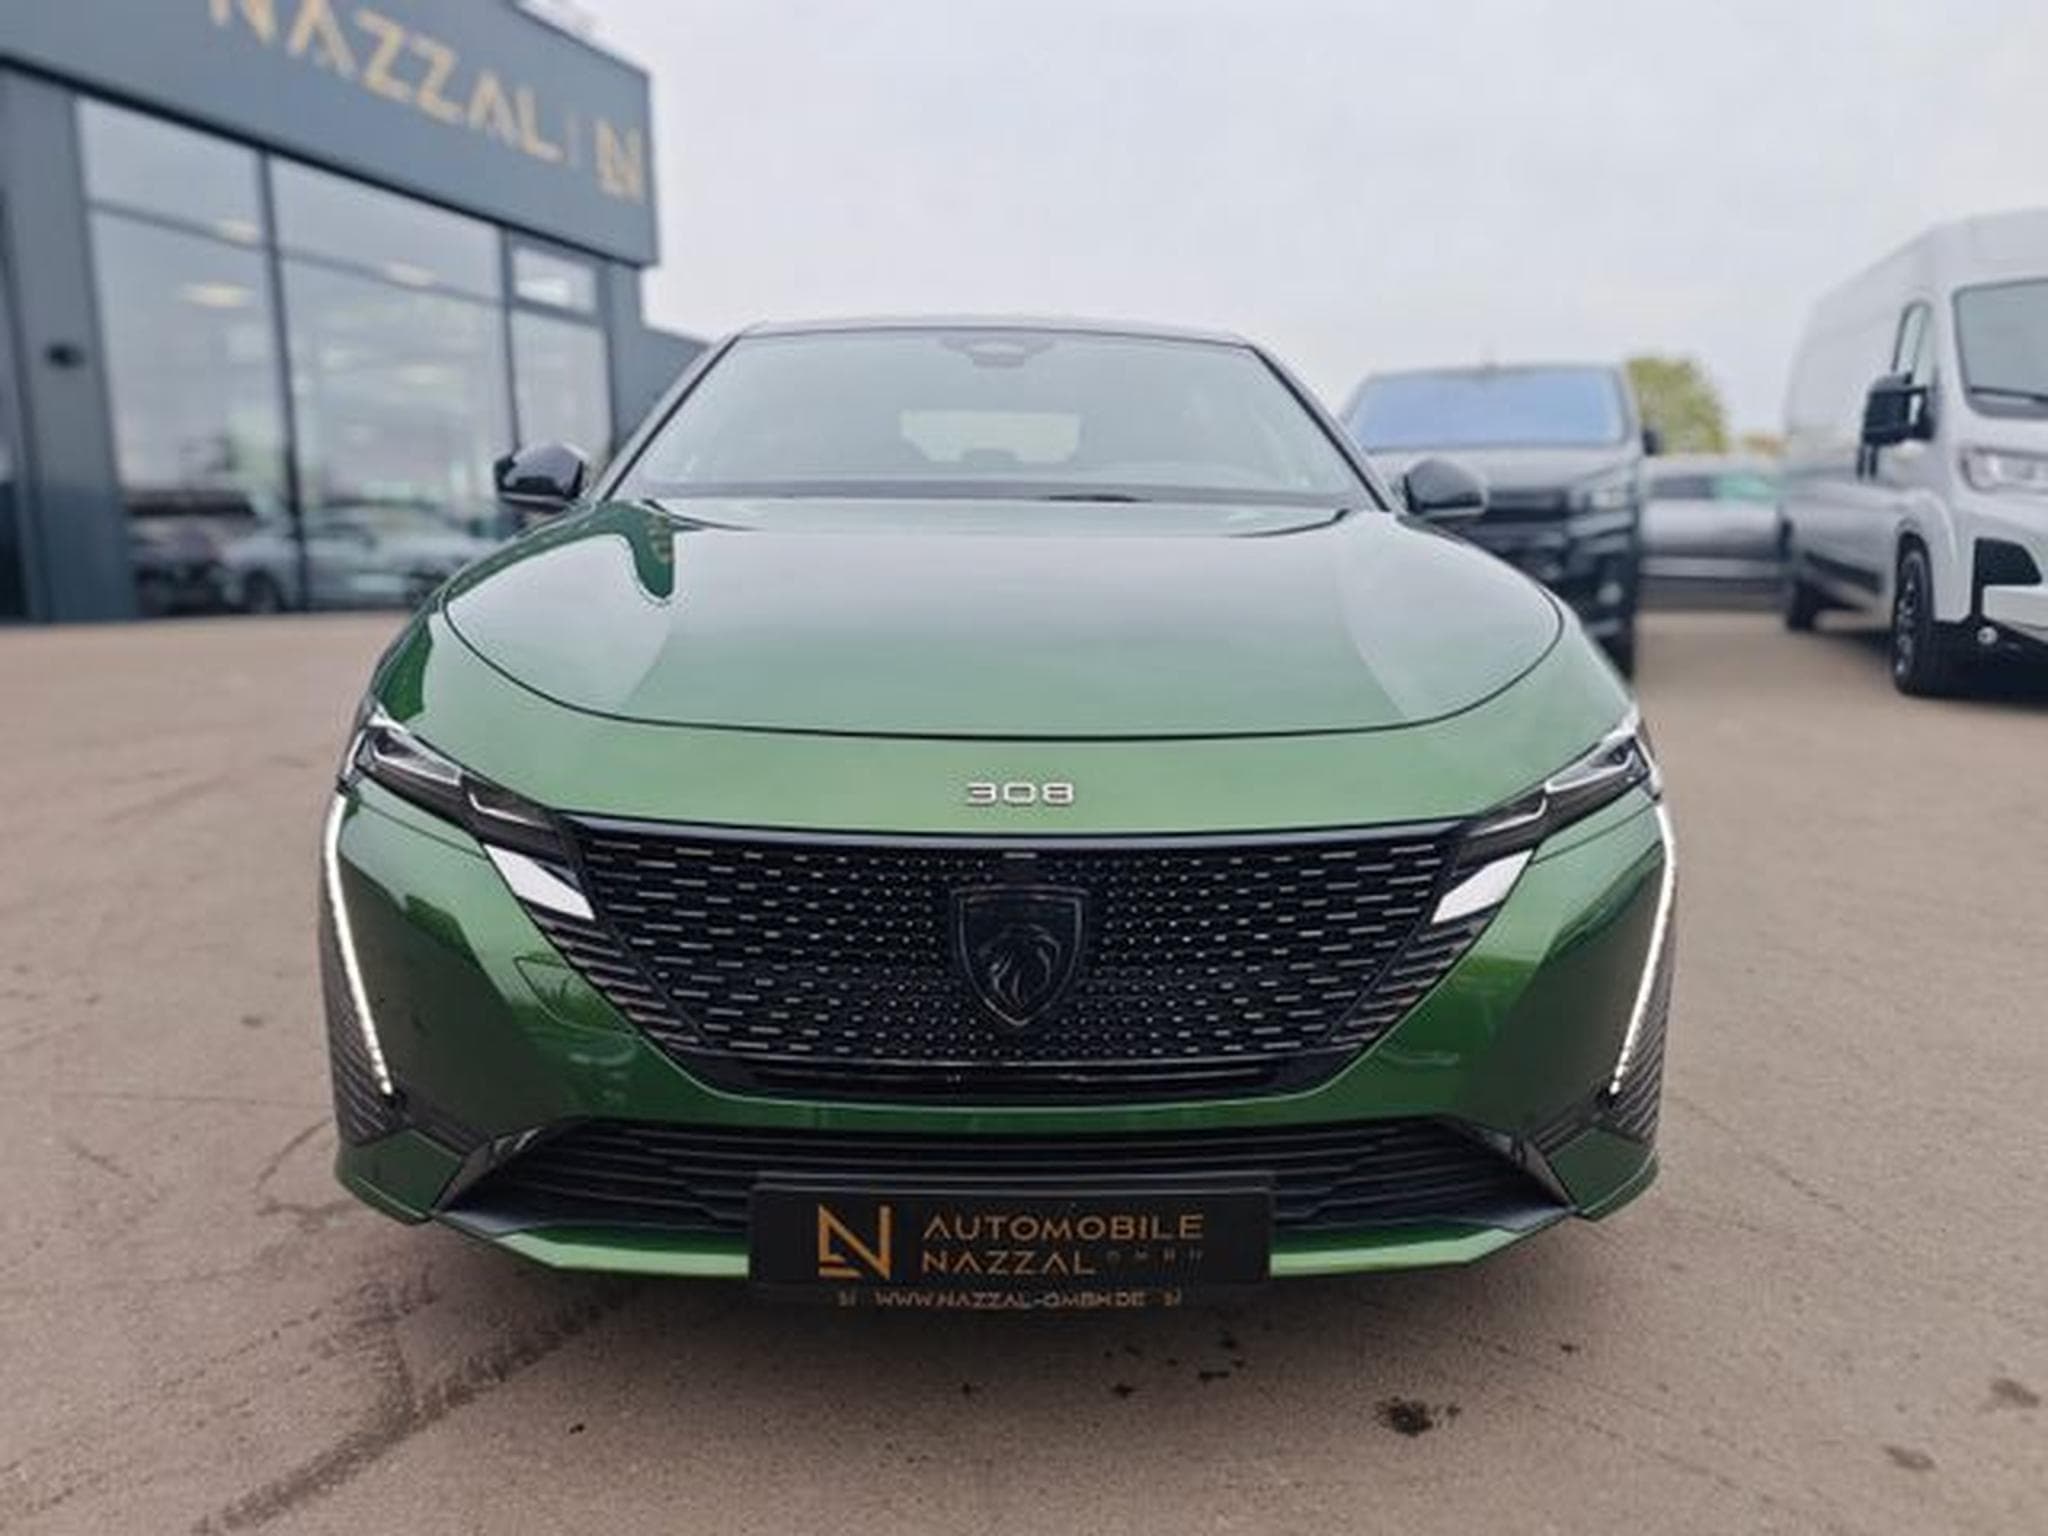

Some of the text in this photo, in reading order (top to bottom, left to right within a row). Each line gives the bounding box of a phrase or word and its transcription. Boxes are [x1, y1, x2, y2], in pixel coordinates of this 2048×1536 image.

[967, 783, 1074, 805] 308
[923, 1214, 1204, 1240] AUTOMOBILE
[922, 1249, 1096, 1275] NAZZAL
